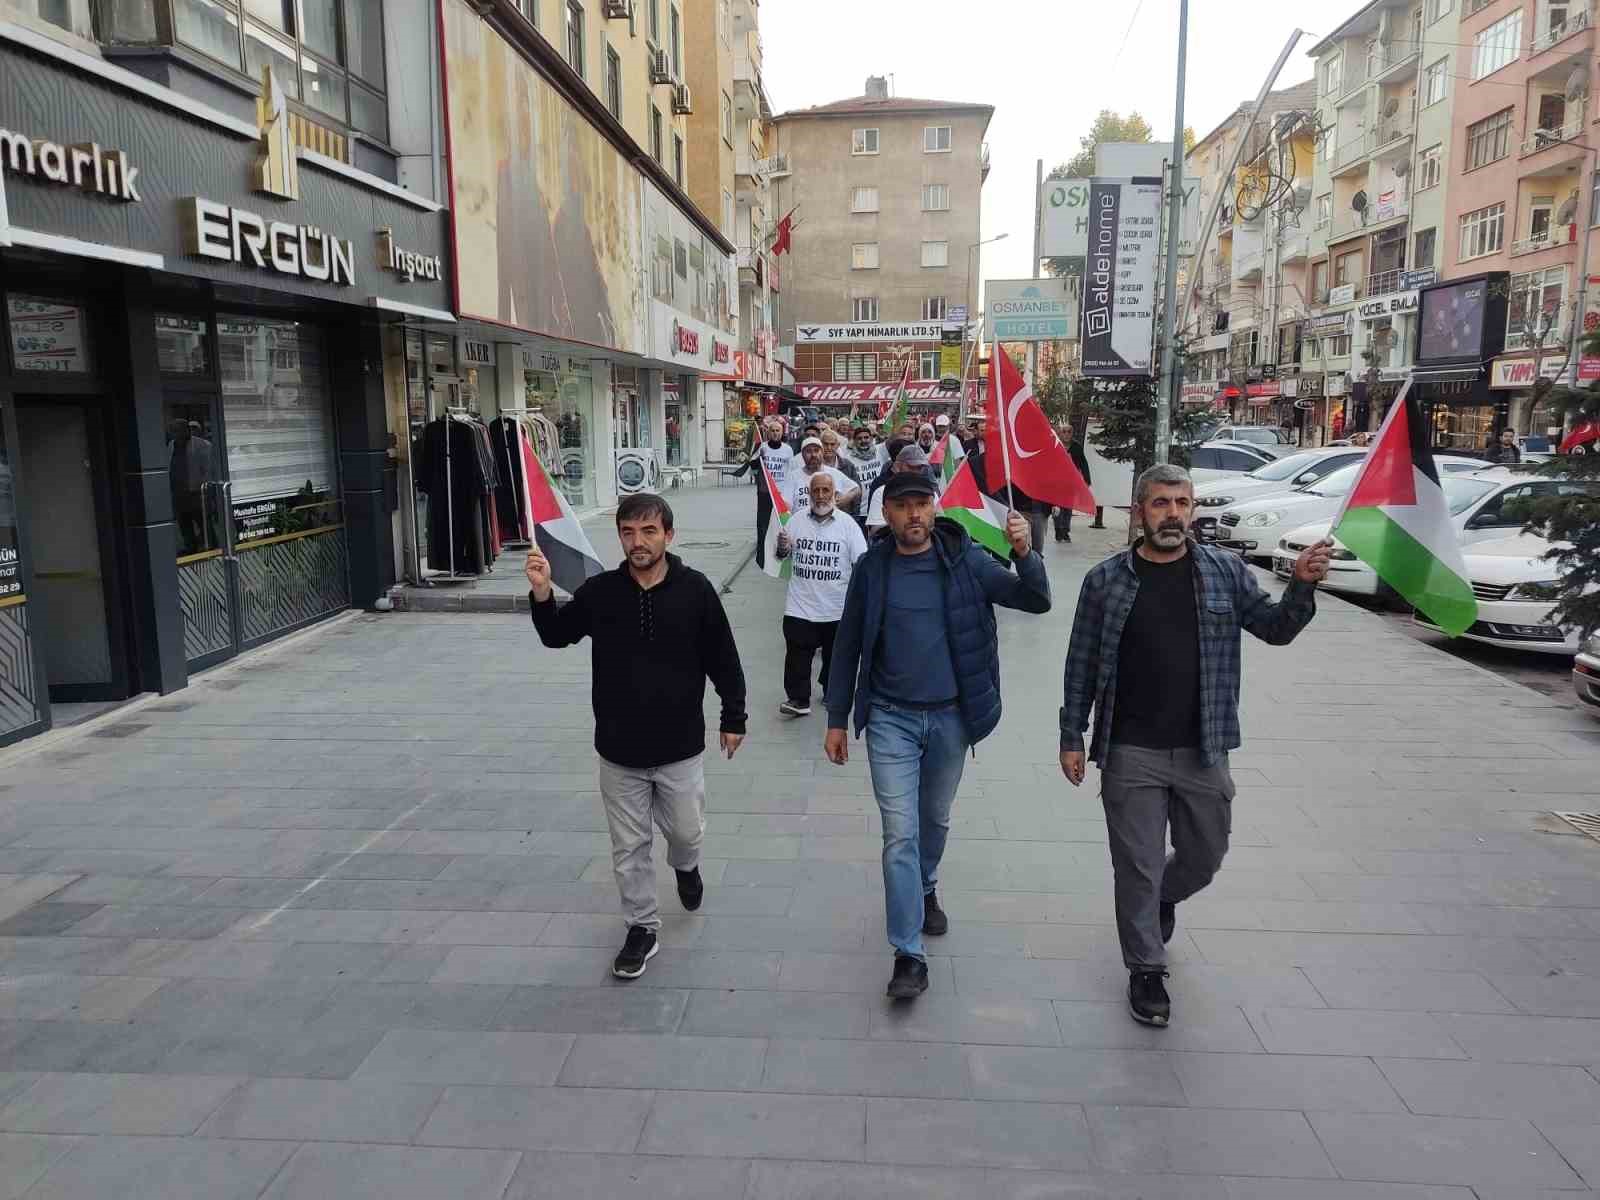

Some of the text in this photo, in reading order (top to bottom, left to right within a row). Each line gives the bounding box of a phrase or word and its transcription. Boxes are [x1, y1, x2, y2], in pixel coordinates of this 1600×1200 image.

[196, 197, 356, 286] ERGÜN
[1091, 193, 1114, 304] aldehome
[388, 227, 442, 283] İnşaat
[993, 302, 1067, 313] OSMANBEY
[828, 328, 846, 338] SYF
[847, 328, 865, 337] YAPI
[867, 326, 908, 337] MİMARLIK
[1007, 320, 1055, 334] HOTEL
[801, 386, 864, 400] Yıldız
[0, 547, 17, 561] ÜN
